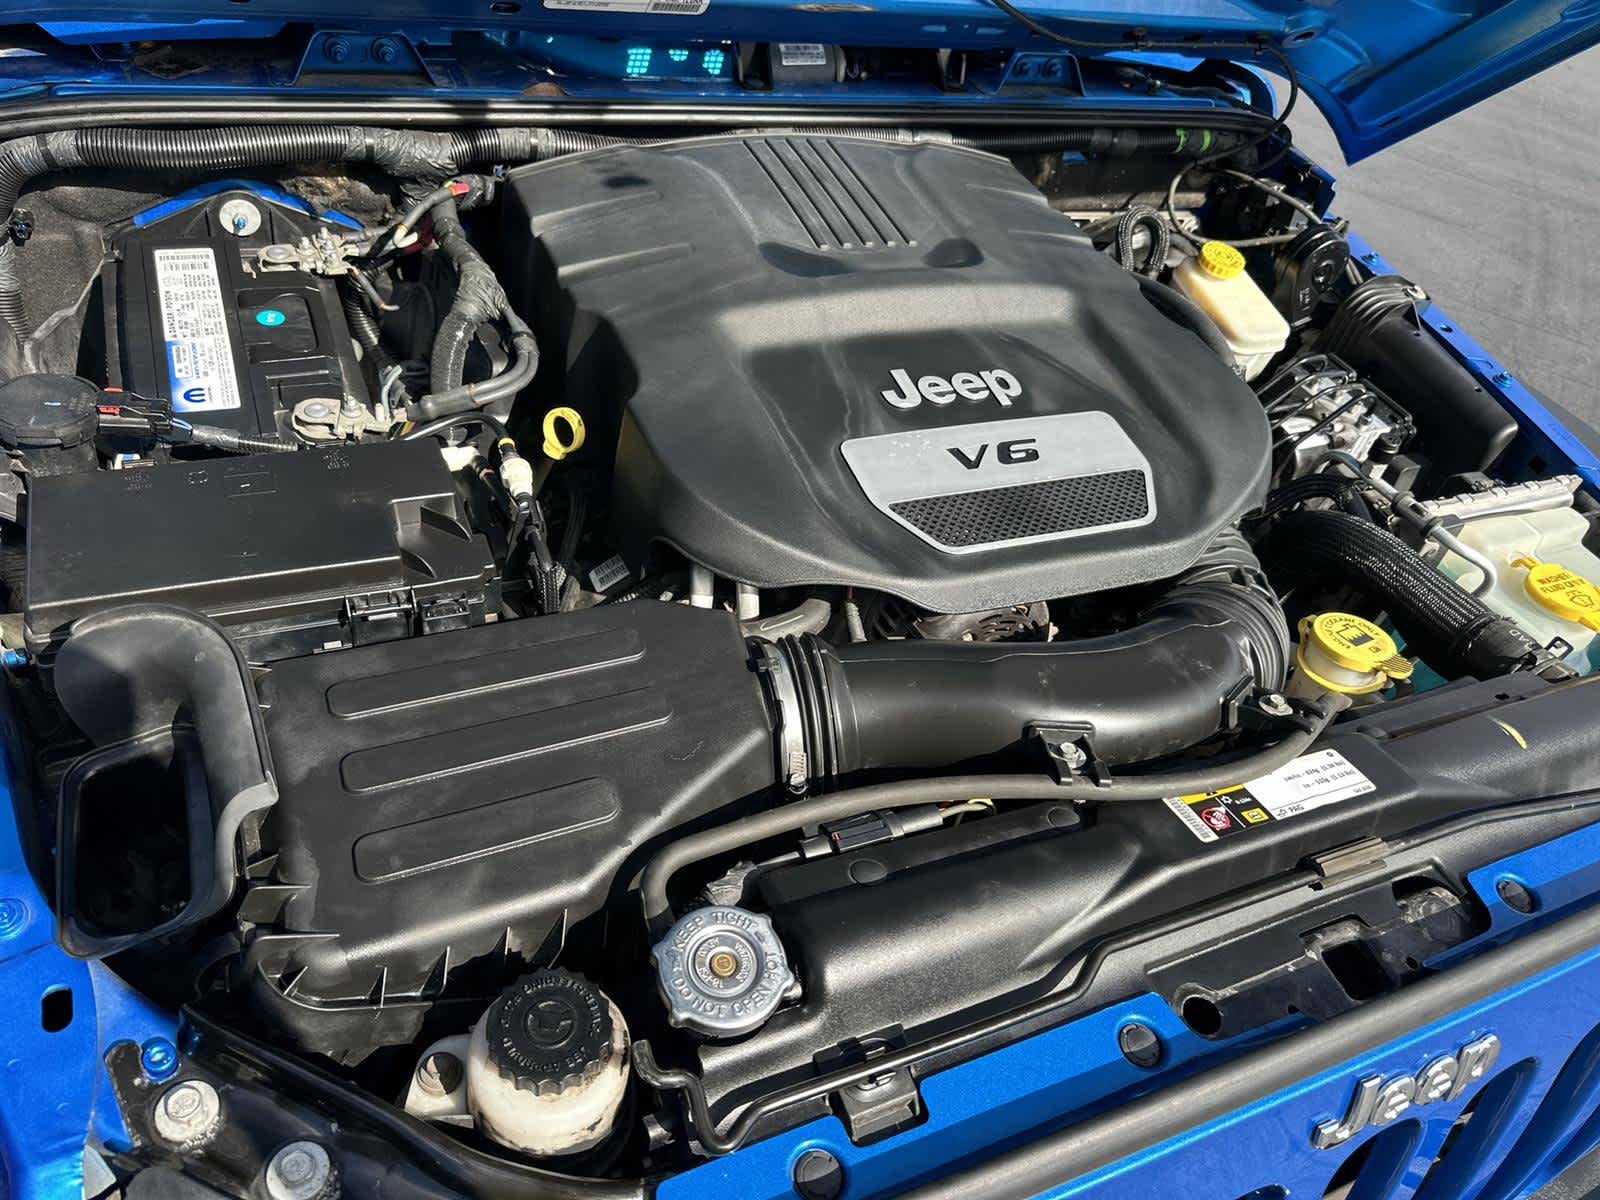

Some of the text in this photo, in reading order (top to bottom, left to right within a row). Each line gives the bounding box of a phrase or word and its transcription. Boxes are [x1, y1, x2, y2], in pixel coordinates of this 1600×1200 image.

[880, 367, 1023, 409] Jeep
[946, 438, 1040, 470] V6
[671, 915, 704, 952] KEEP
[711, 911, 758, 931] TIGHT
[671, 977, 692, 999] DO
[692, 998, 727, 1017] NOT
[731, 983, 774, 1016] OPEN
[1310, 1032, 1501, 1150] Jeep
